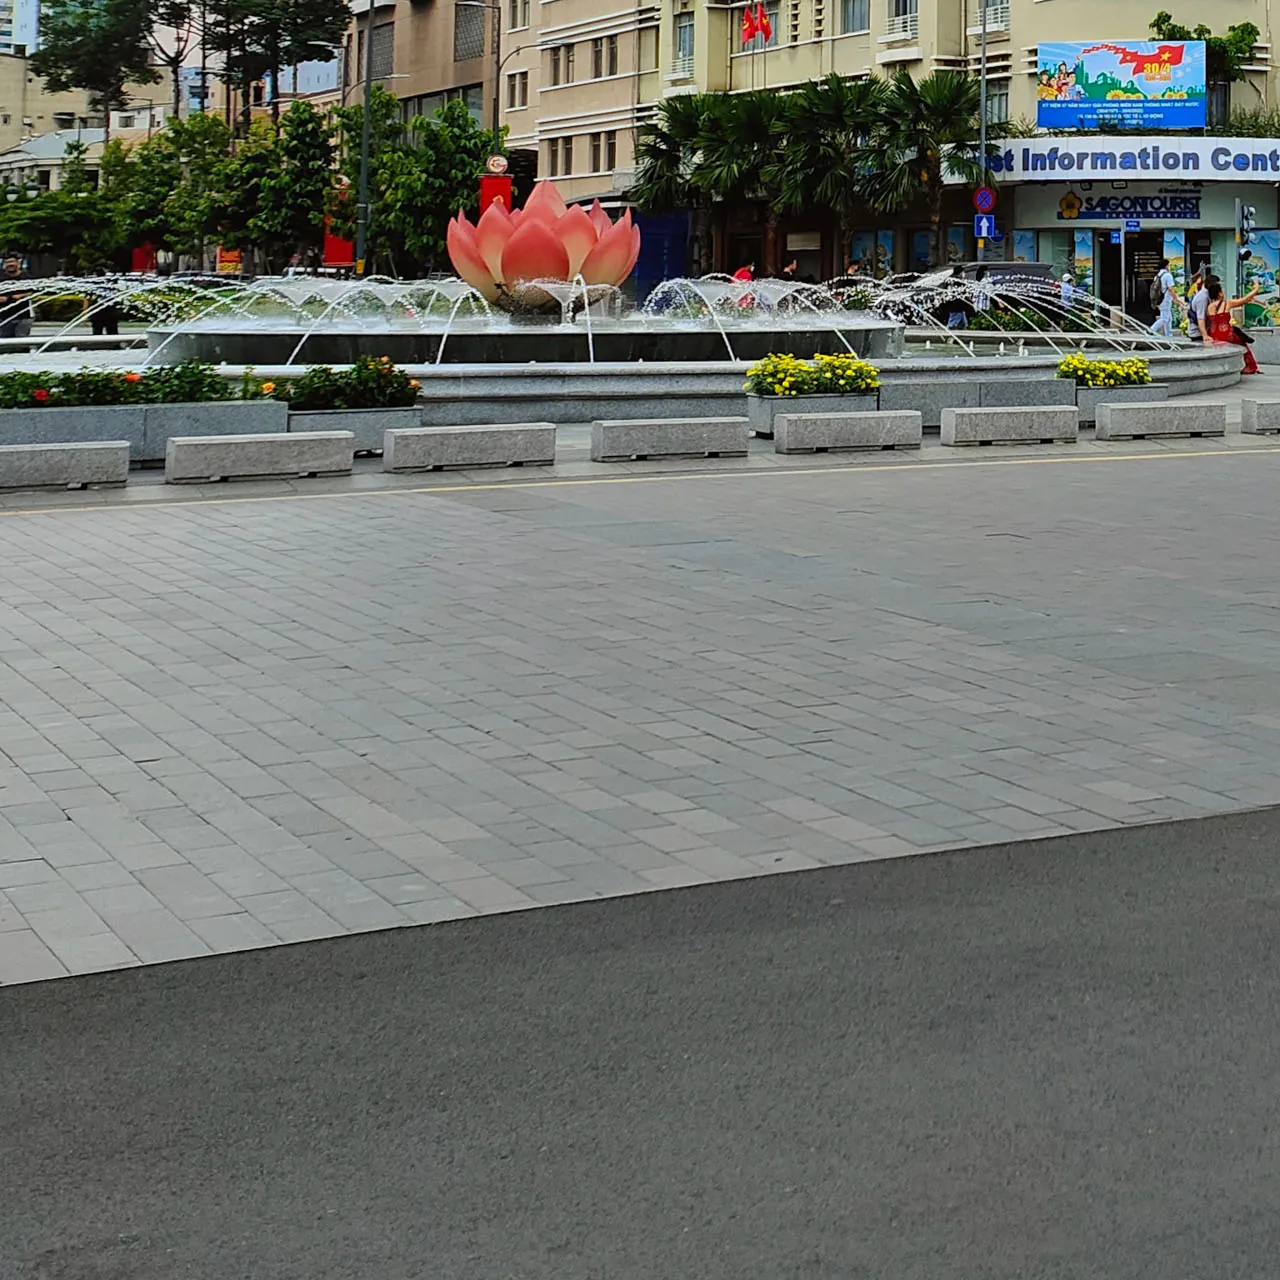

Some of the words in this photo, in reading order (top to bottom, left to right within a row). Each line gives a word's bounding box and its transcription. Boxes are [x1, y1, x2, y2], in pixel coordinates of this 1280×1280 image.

[1143, 62, 1171, 74] 30/4
[1022, 145, 1200, 171] Information
[1084, 196, 1202, 212] SAIGONTOURIST
